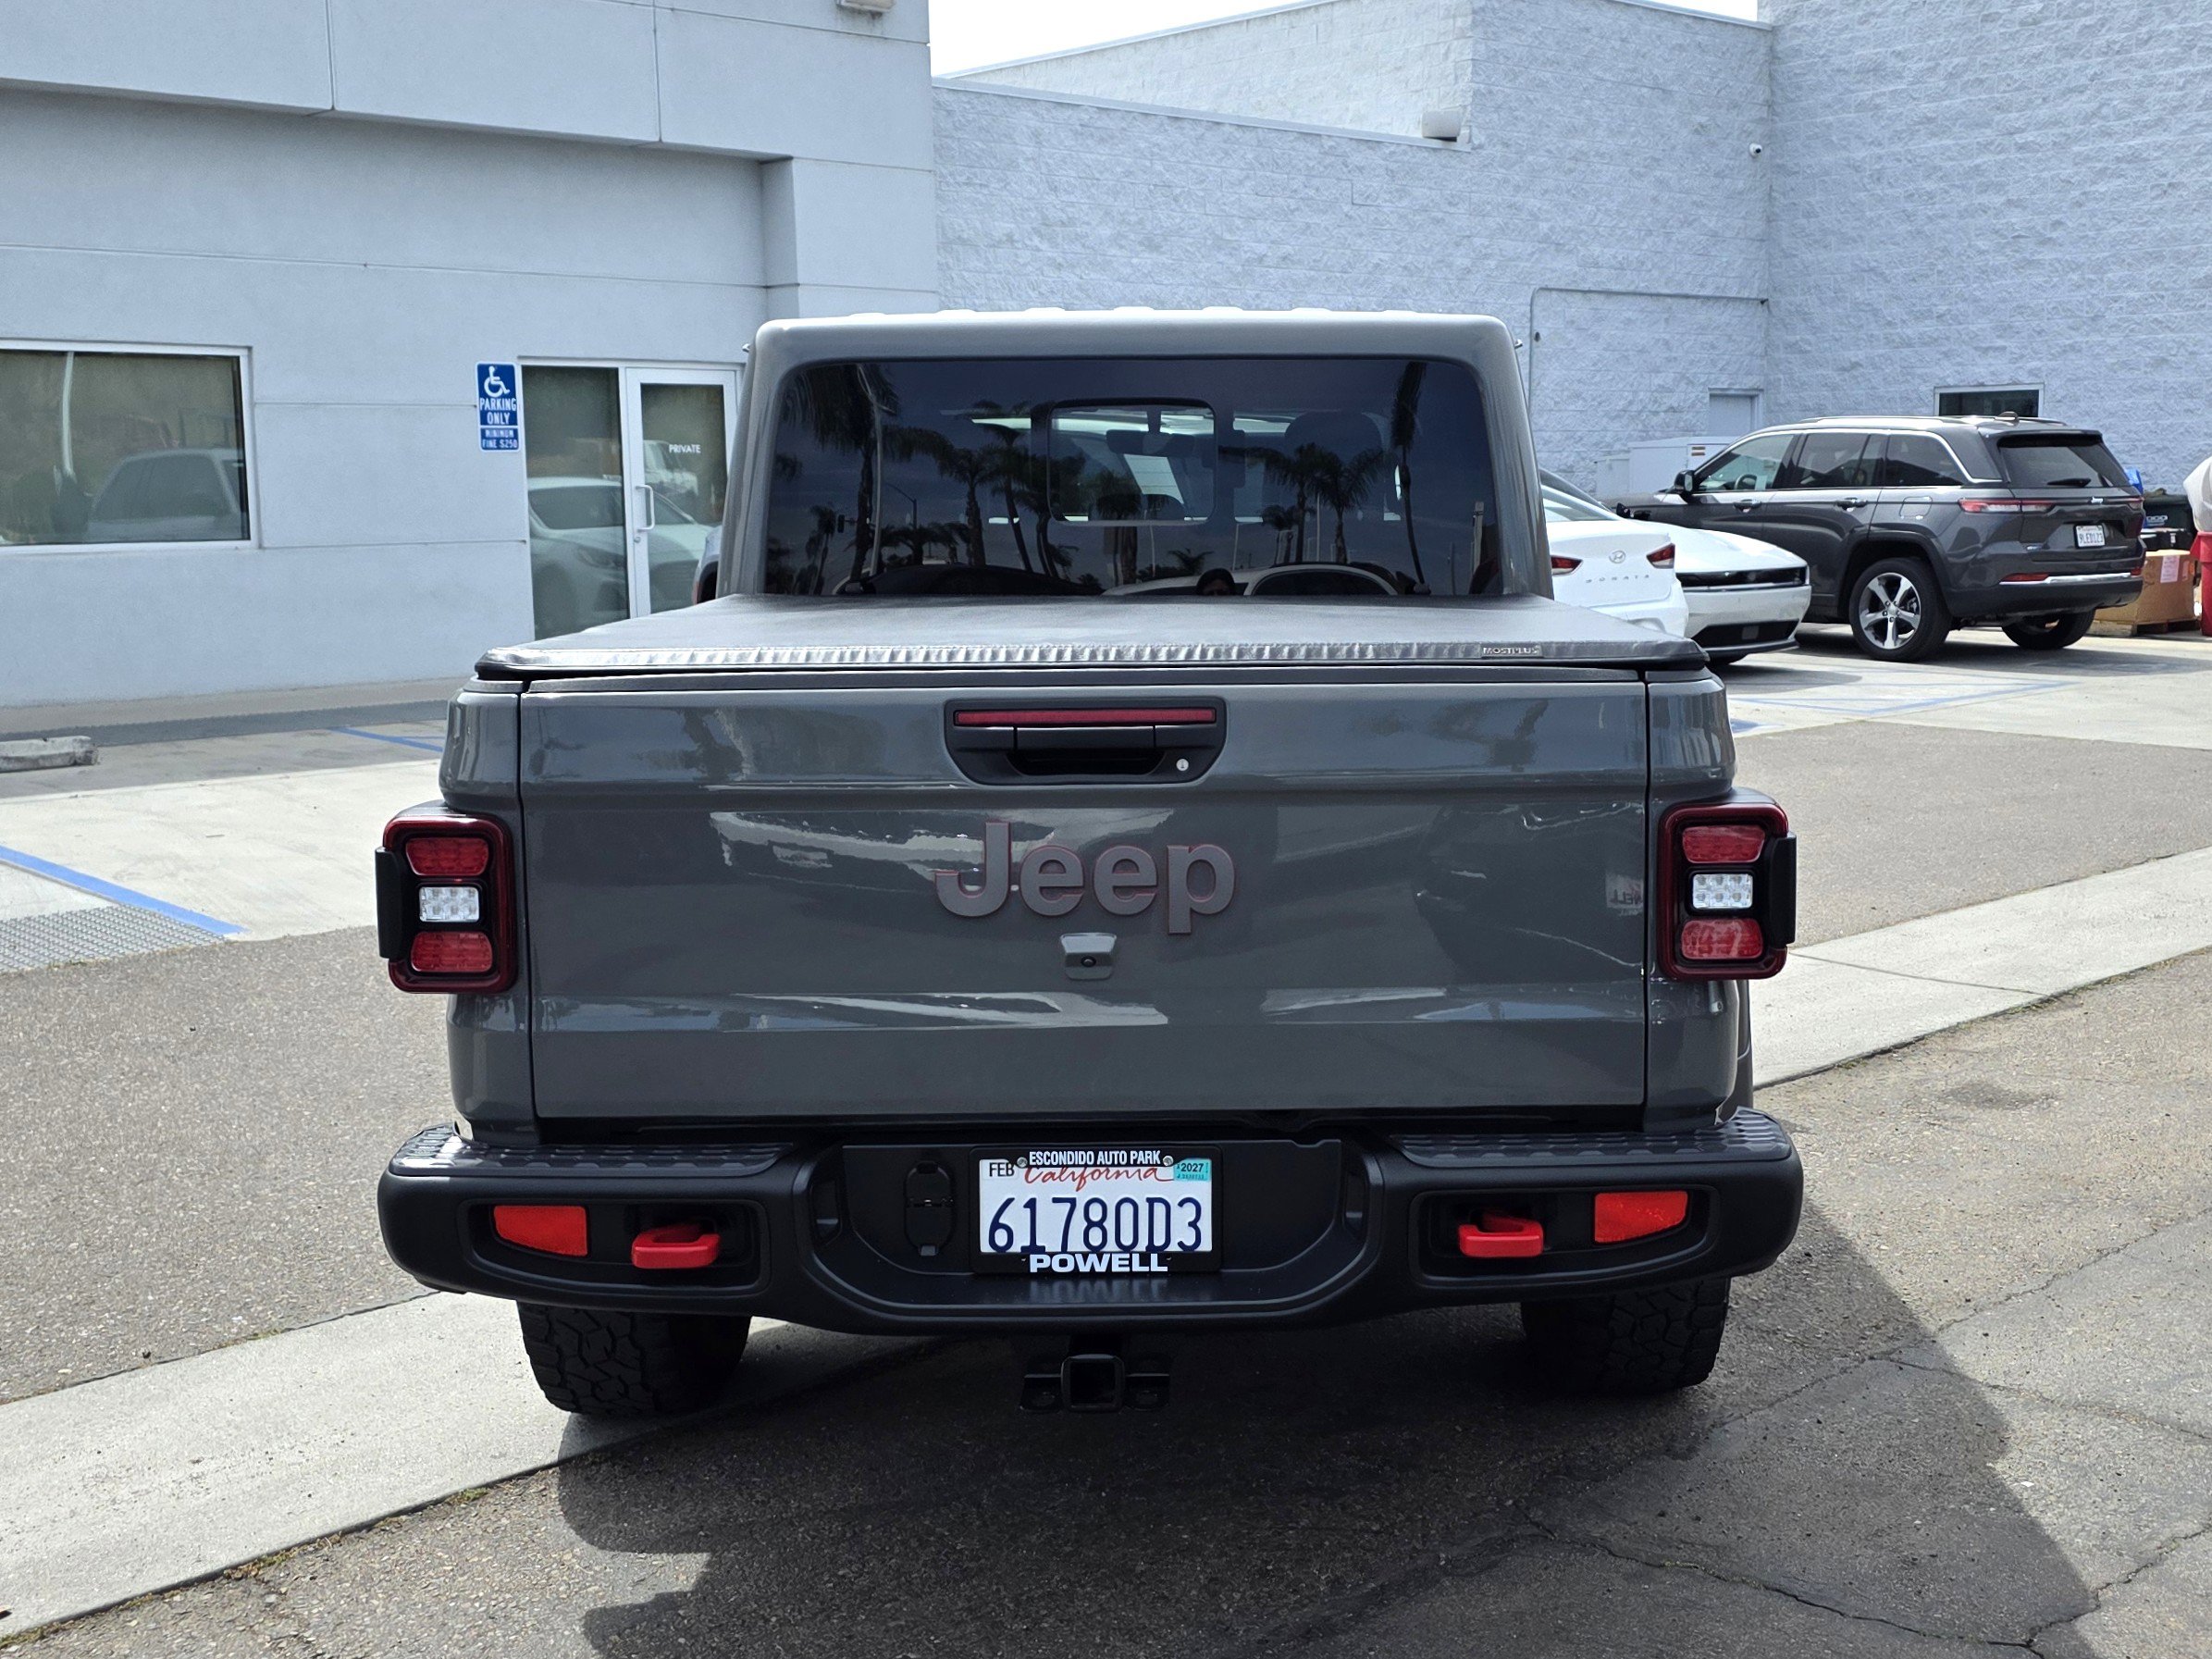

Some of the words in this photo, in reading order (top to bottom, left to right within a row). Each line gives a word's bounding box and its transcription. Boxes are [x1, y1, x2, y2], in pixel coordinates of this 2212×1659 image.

[479, 398, 517, 411] PARKING
[487, 412, 510, 425] ONLY
[482, 439, 497, 449] FINE
[500, 439, 518, 449] $250
[669, 443, 701, 453] PRIVATE
[934, 821, 1235, 935] Jeep
[1029, 1151, 1094, 1166] ESCONDIDO
[1096, 1150, 1129, 1165] AUTO
[1131, 1150, 1161, 1165] PARK
[989, 1162, 1015, 1177] FEB
[1180, 1162, 1205, 1172] 2027
[1023, 1166, 1174, 1192] California
[988, 1196, 1202, 1253] 61780D3
[1029, 1253, 1168, 1272] POWELL
